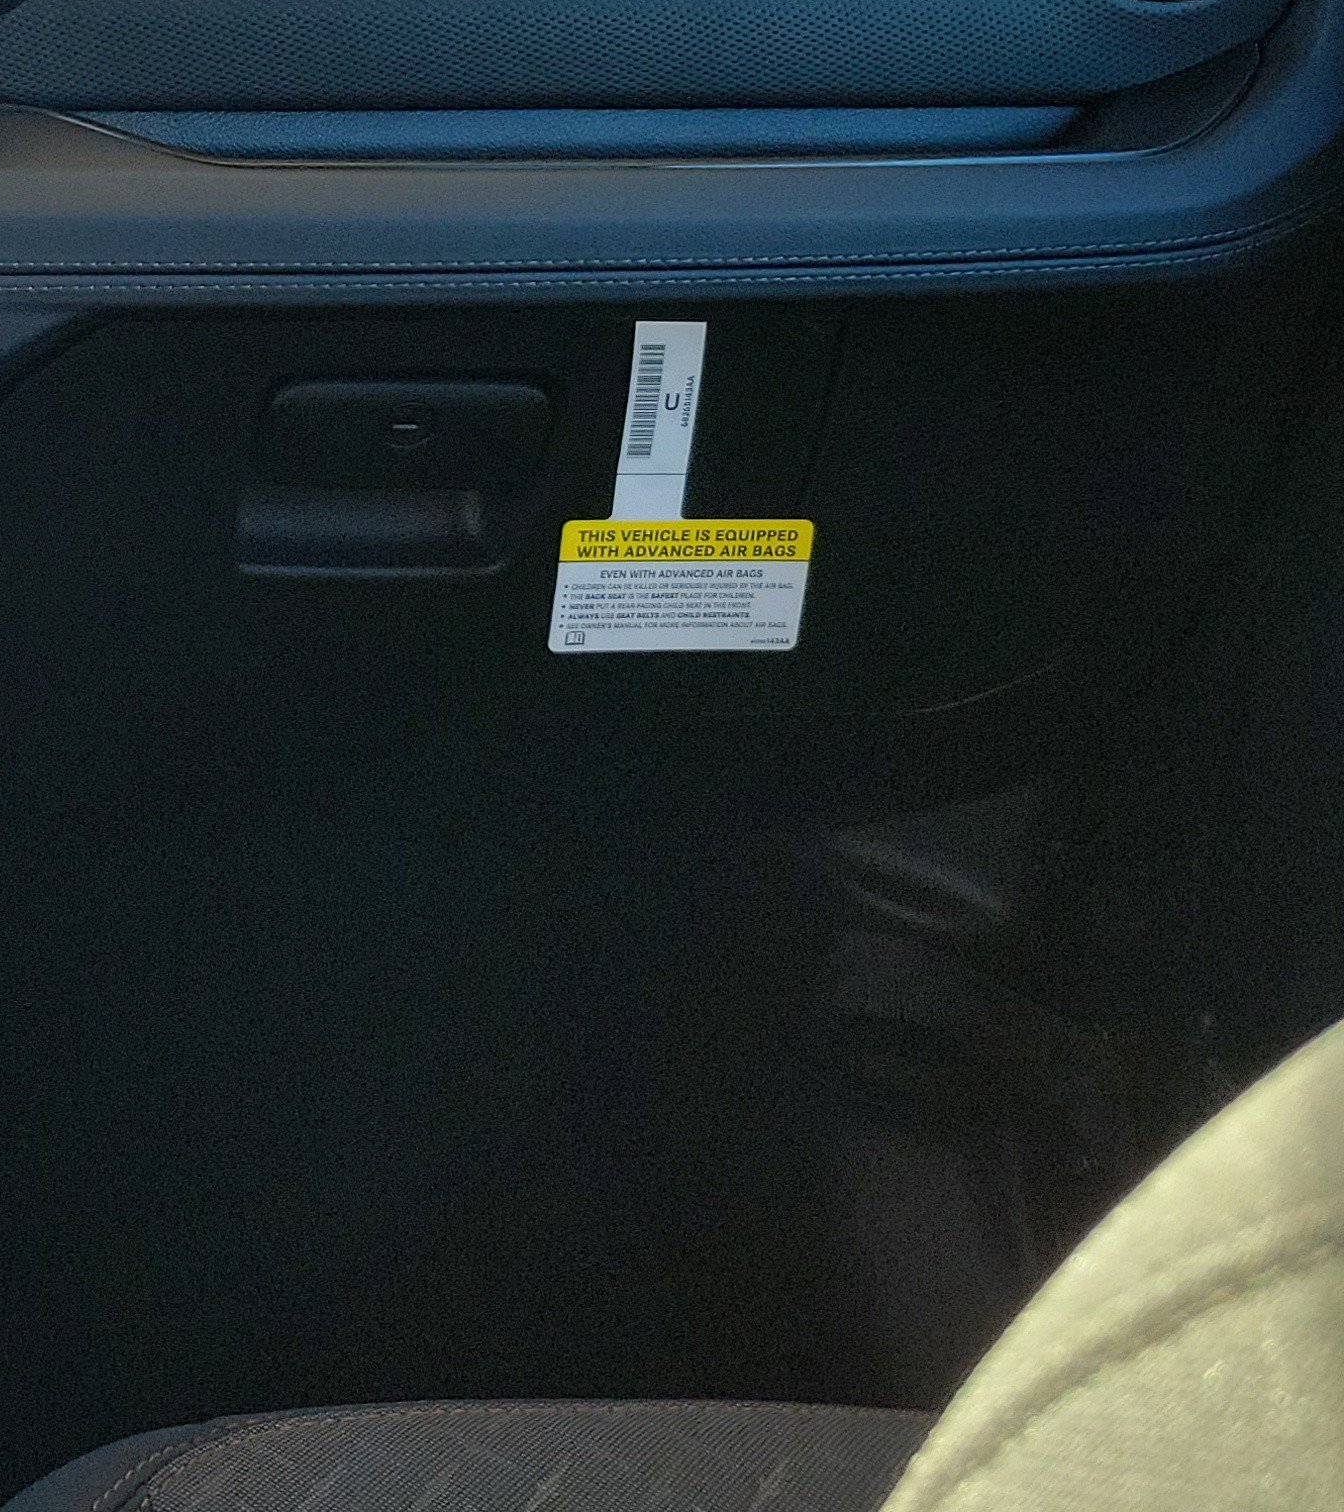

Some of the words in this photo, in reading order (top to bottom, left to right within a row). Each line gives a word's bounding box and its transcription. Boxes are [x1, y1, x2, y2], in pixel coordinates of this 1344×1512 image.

[578, 530, 616, 542] THIS
[621, 530, 690, 542] VEHICLE
[695, 530, 710, 541] IS
[715, 530, 799, 542] EQUIPPED
[577, 546, 618, 557] WITH
[624, 546, 715, 557] ADVANCED
[719, 546, 747, 556] AIR
[752, 545, 797, 557] BAGS
[600, 570, 627, 578] EVEN
[630, 570, 656, 578] WITH
[658, 570, 713, 578] ADVANCED
[716, 570, 733, 578] AIR
[736, 570, 763, 578] BAGS
